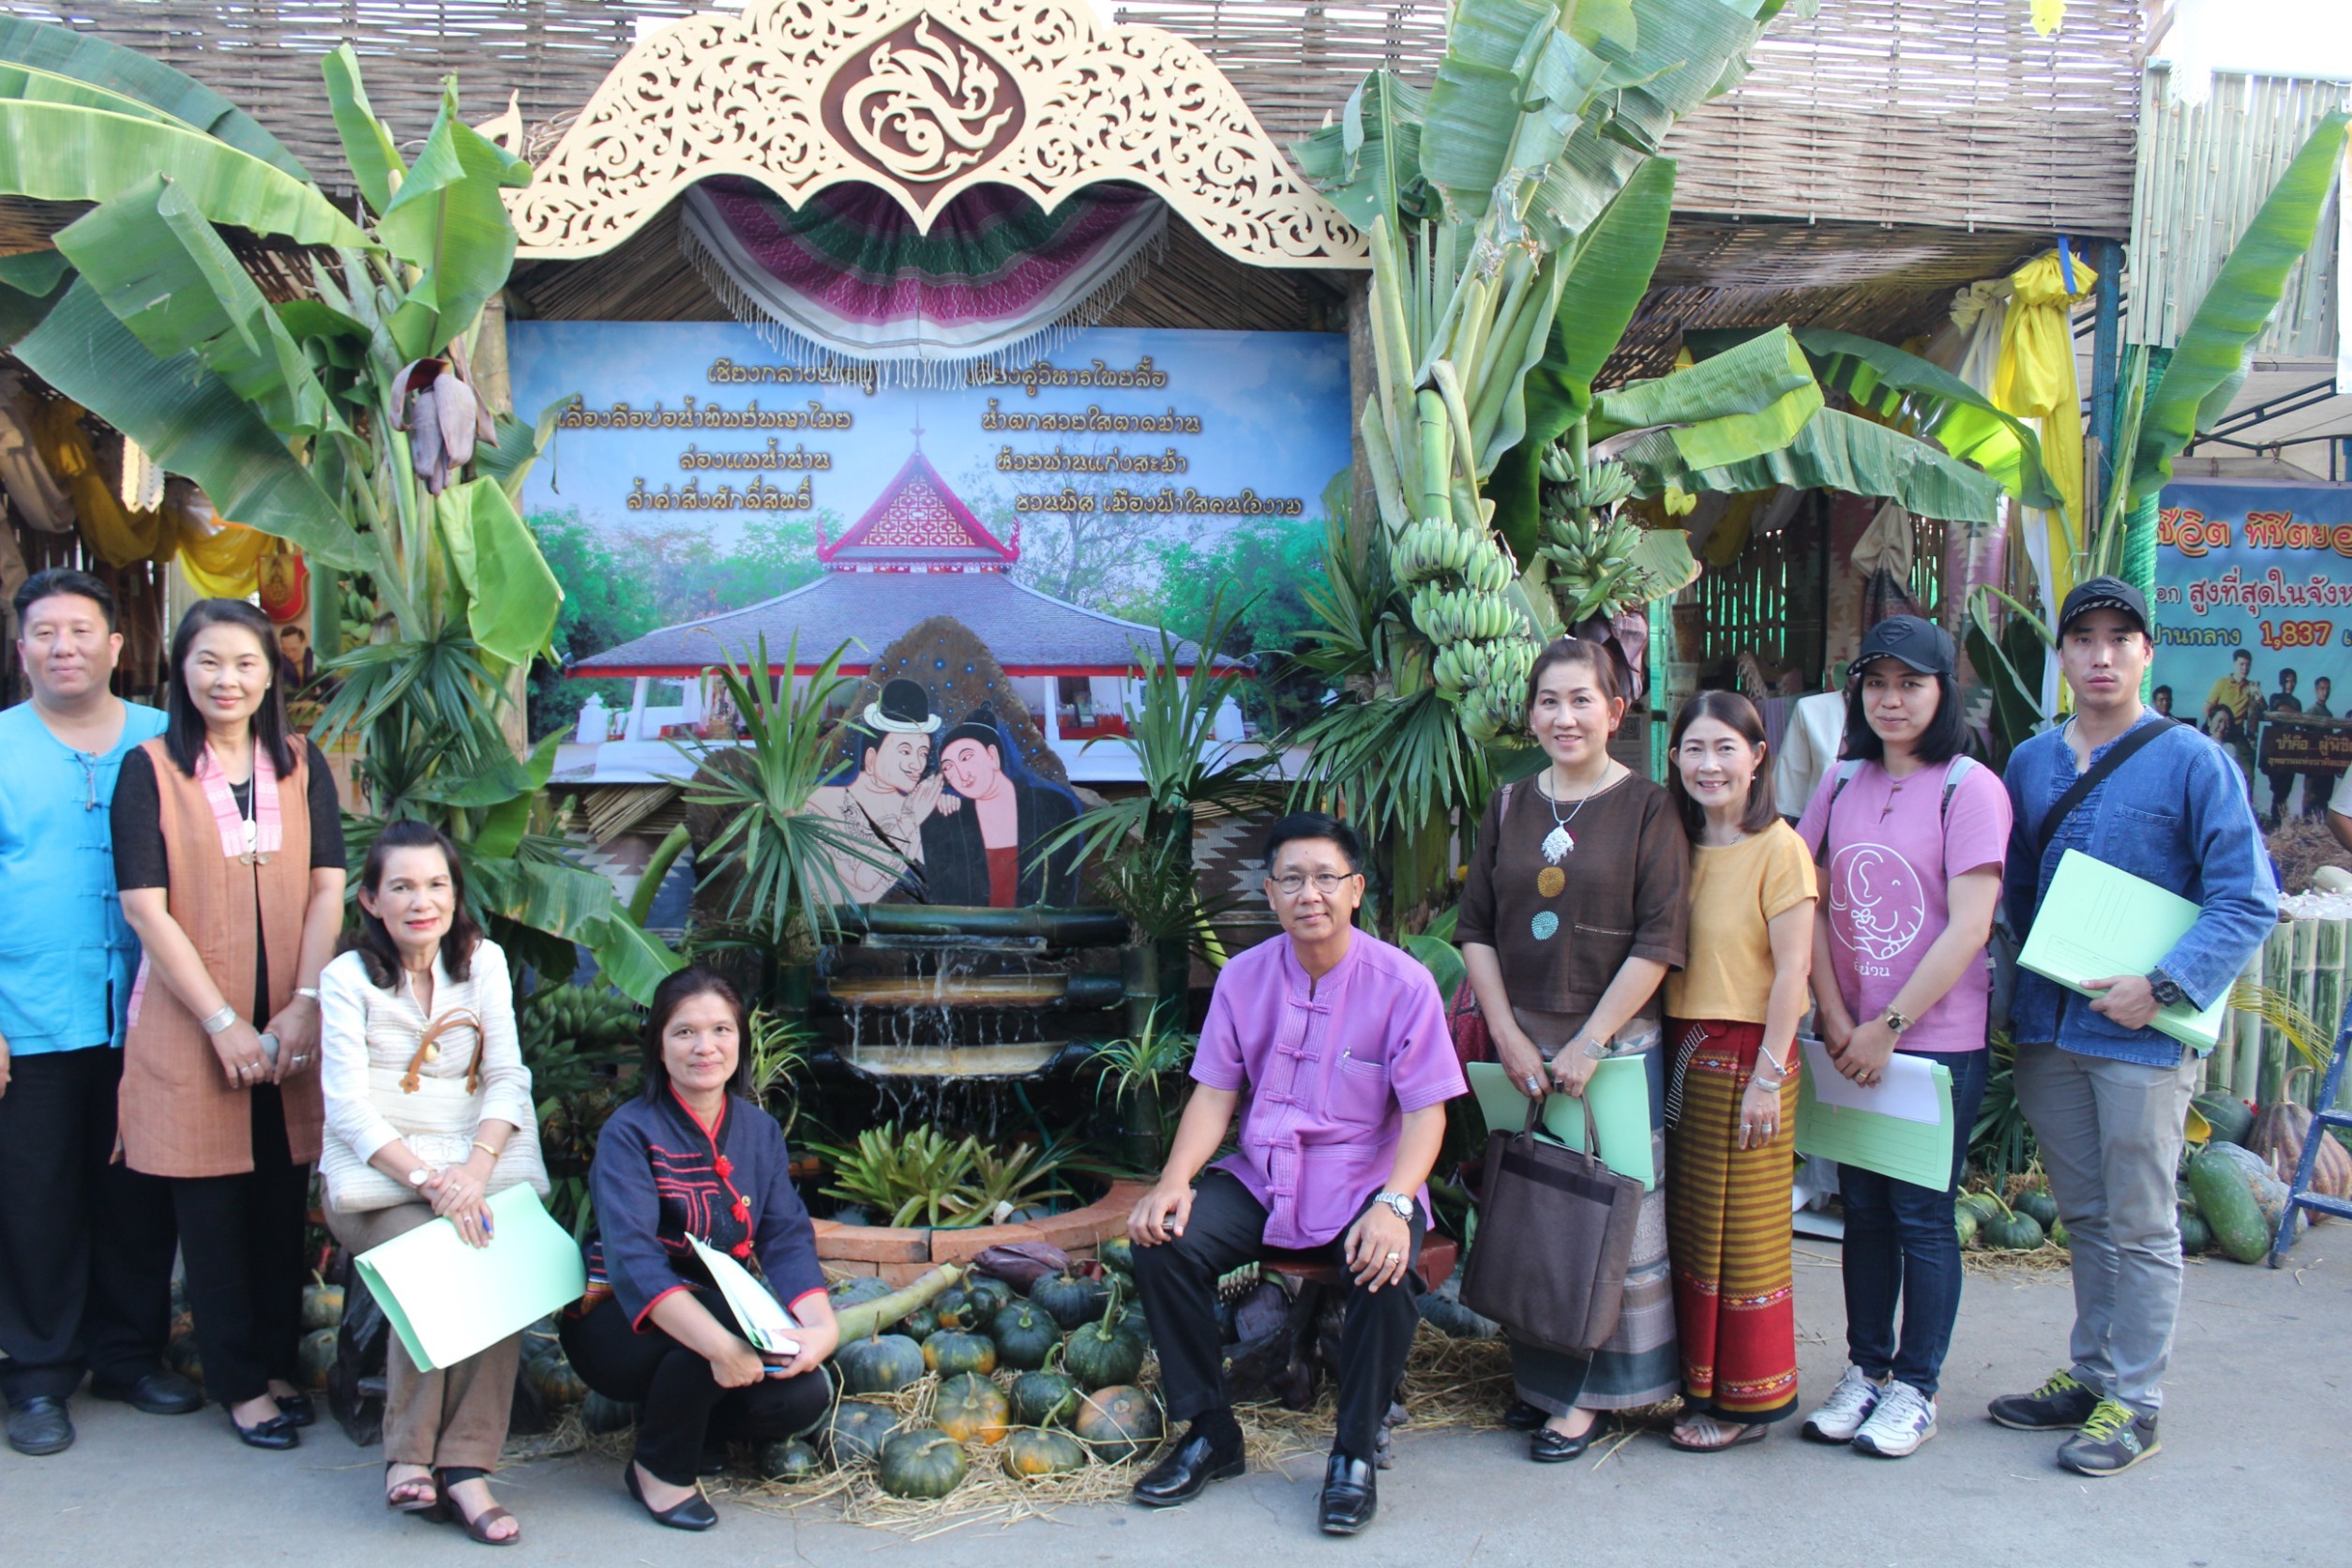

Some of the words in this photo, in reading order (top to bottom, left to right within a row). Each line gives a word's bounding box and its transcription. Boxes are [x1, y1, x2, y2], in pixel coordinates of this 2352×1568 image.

[981, 399, 1201, 432] น้ำตกสวยใสตาดม่าน
[679, 437, 831, 469] ล่องแพน้ำน่าน
[626, 475, 812, 509] ล้ำค่าสิ่งศักดิ์สิทธิ์
[2260, 621, 2332, 650] 1,837
